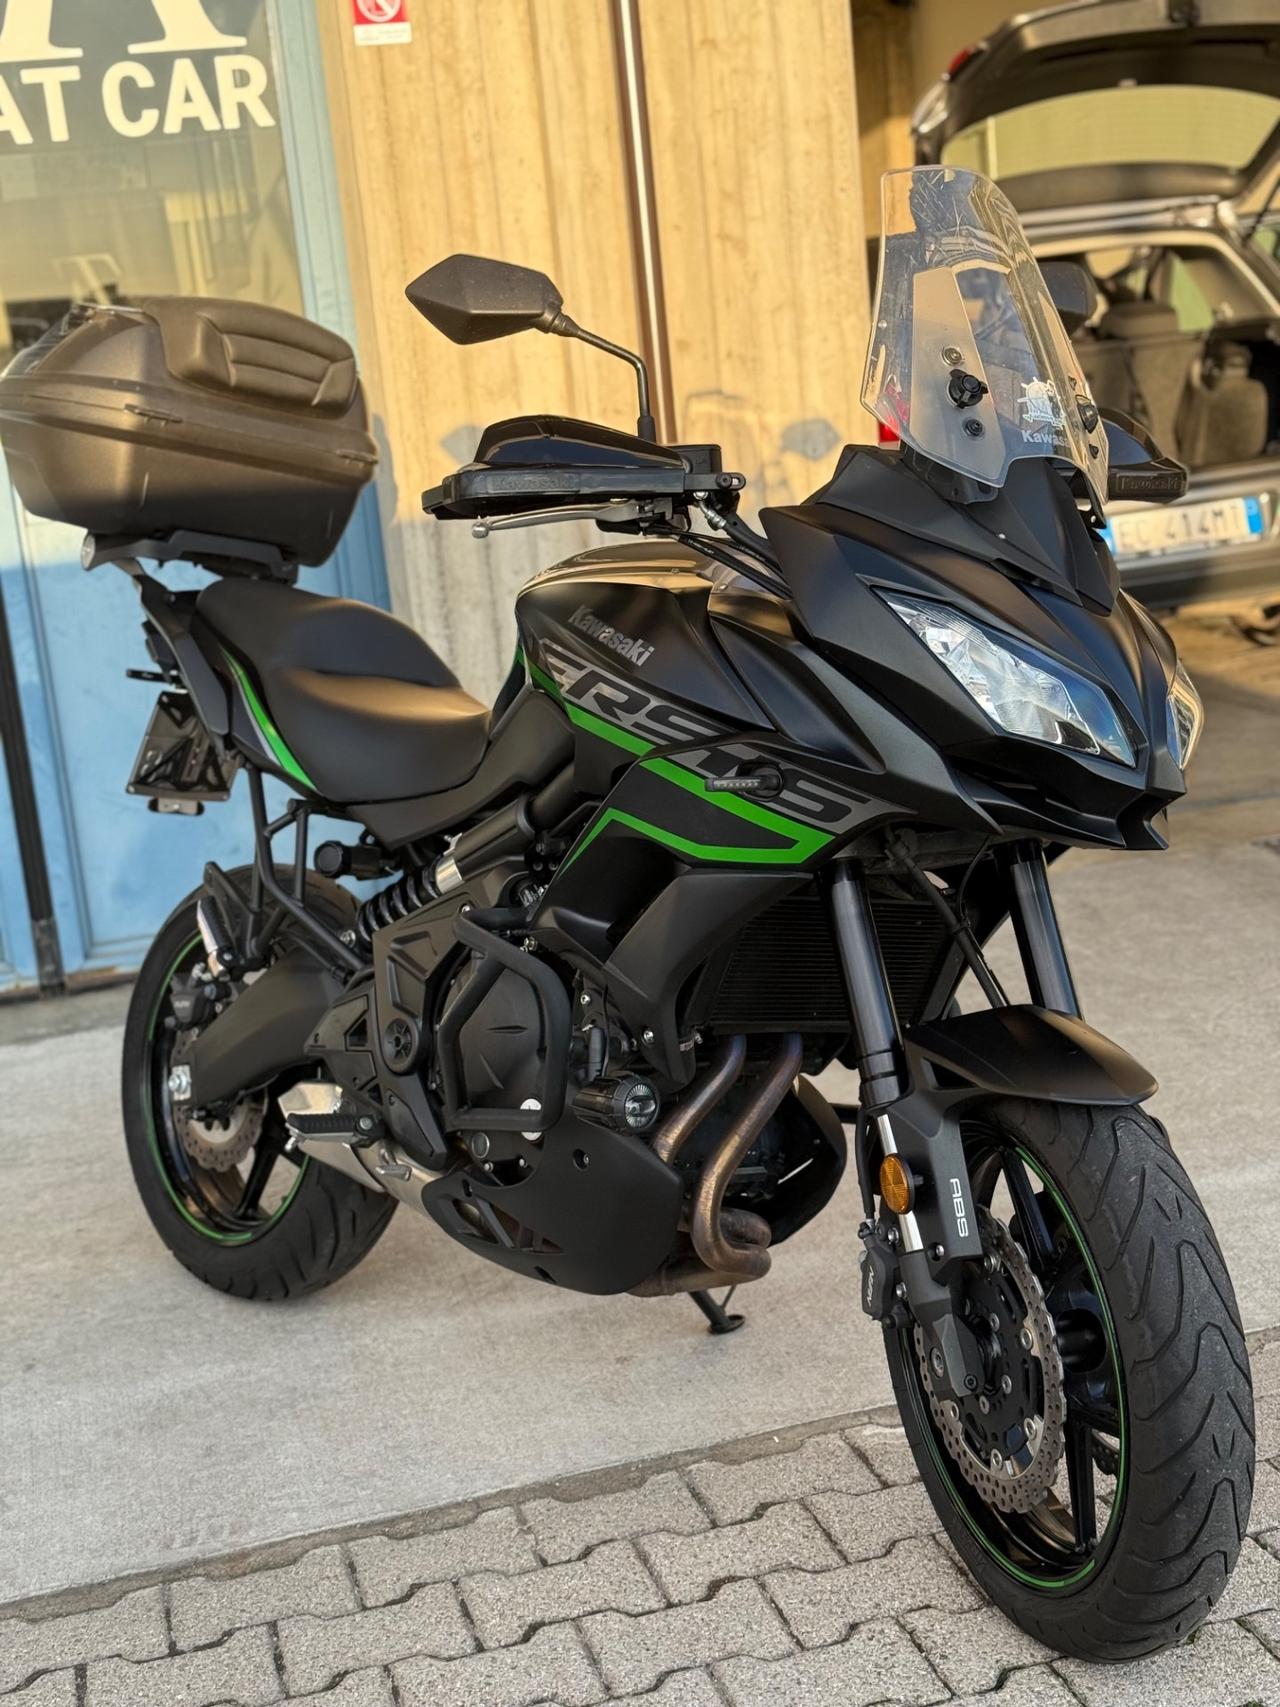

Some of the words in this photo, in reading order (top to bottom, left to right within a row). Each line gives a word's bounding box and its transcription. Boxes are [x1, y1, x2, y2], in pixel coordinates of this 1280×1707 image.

[102, 54, 276, 138] CAR
[567, 604, 655, 668] Kawasaki
[949, 1177, 969, 1238] ABS
